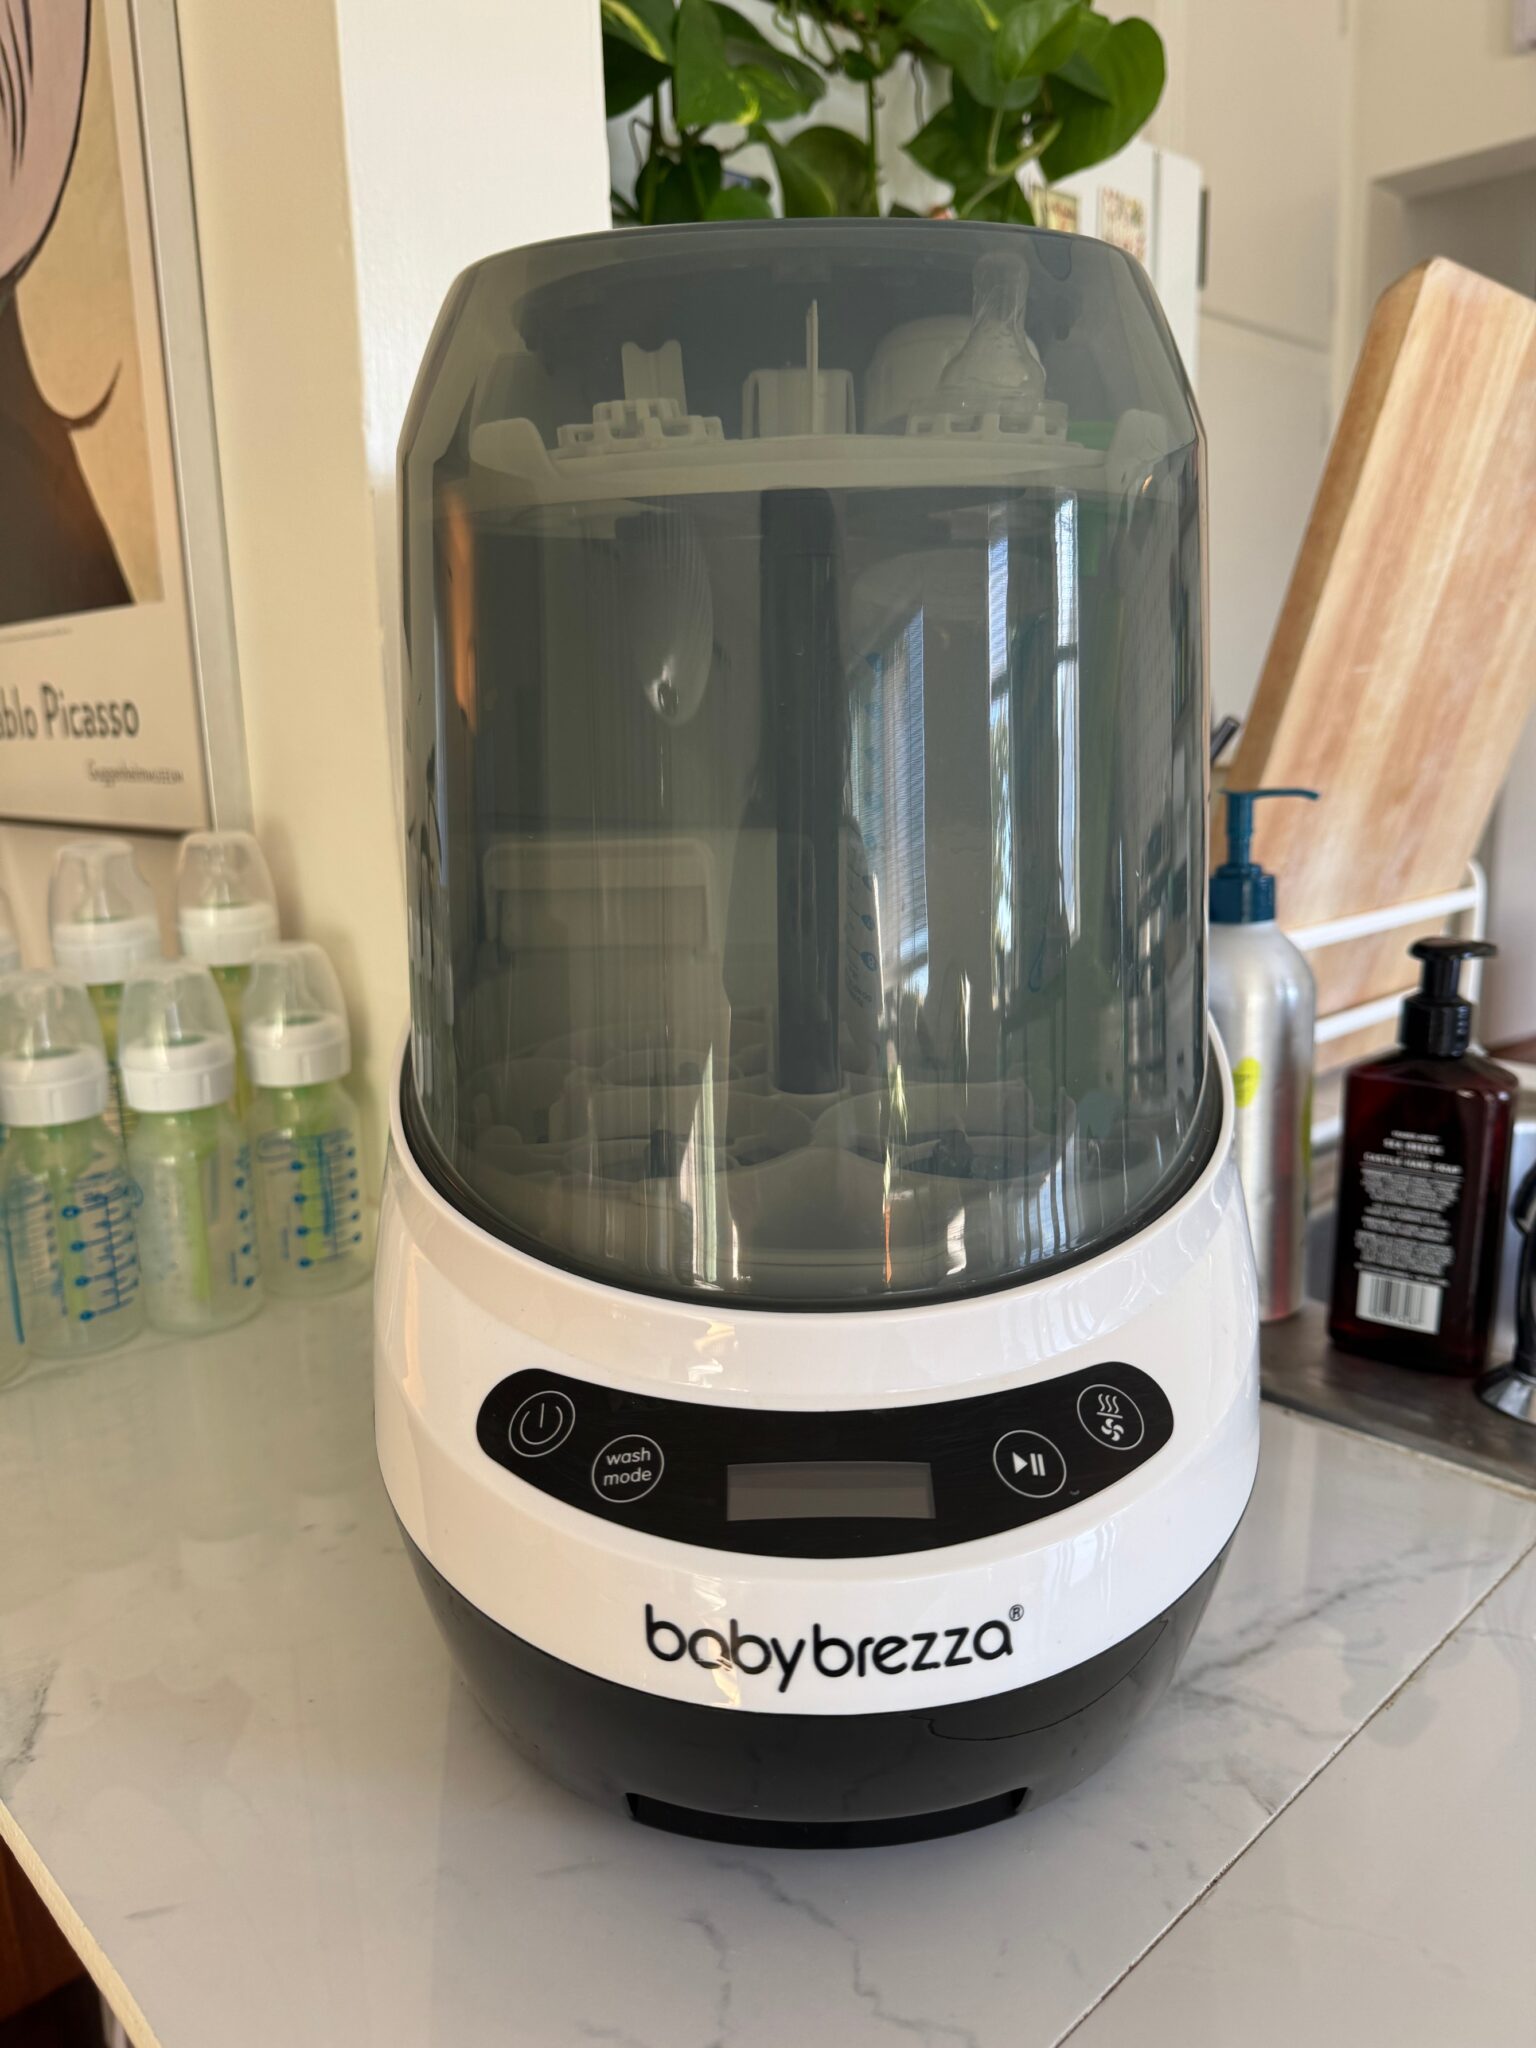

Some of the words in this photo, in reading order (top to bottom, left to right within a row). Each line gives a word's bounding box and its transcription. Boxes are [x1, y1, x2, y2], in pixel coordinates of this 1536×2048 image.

[40, 681, 140, 739] Picasso
[606, 1447, 651, 1466] wash
[604, 1467, 652, 1486] mode
